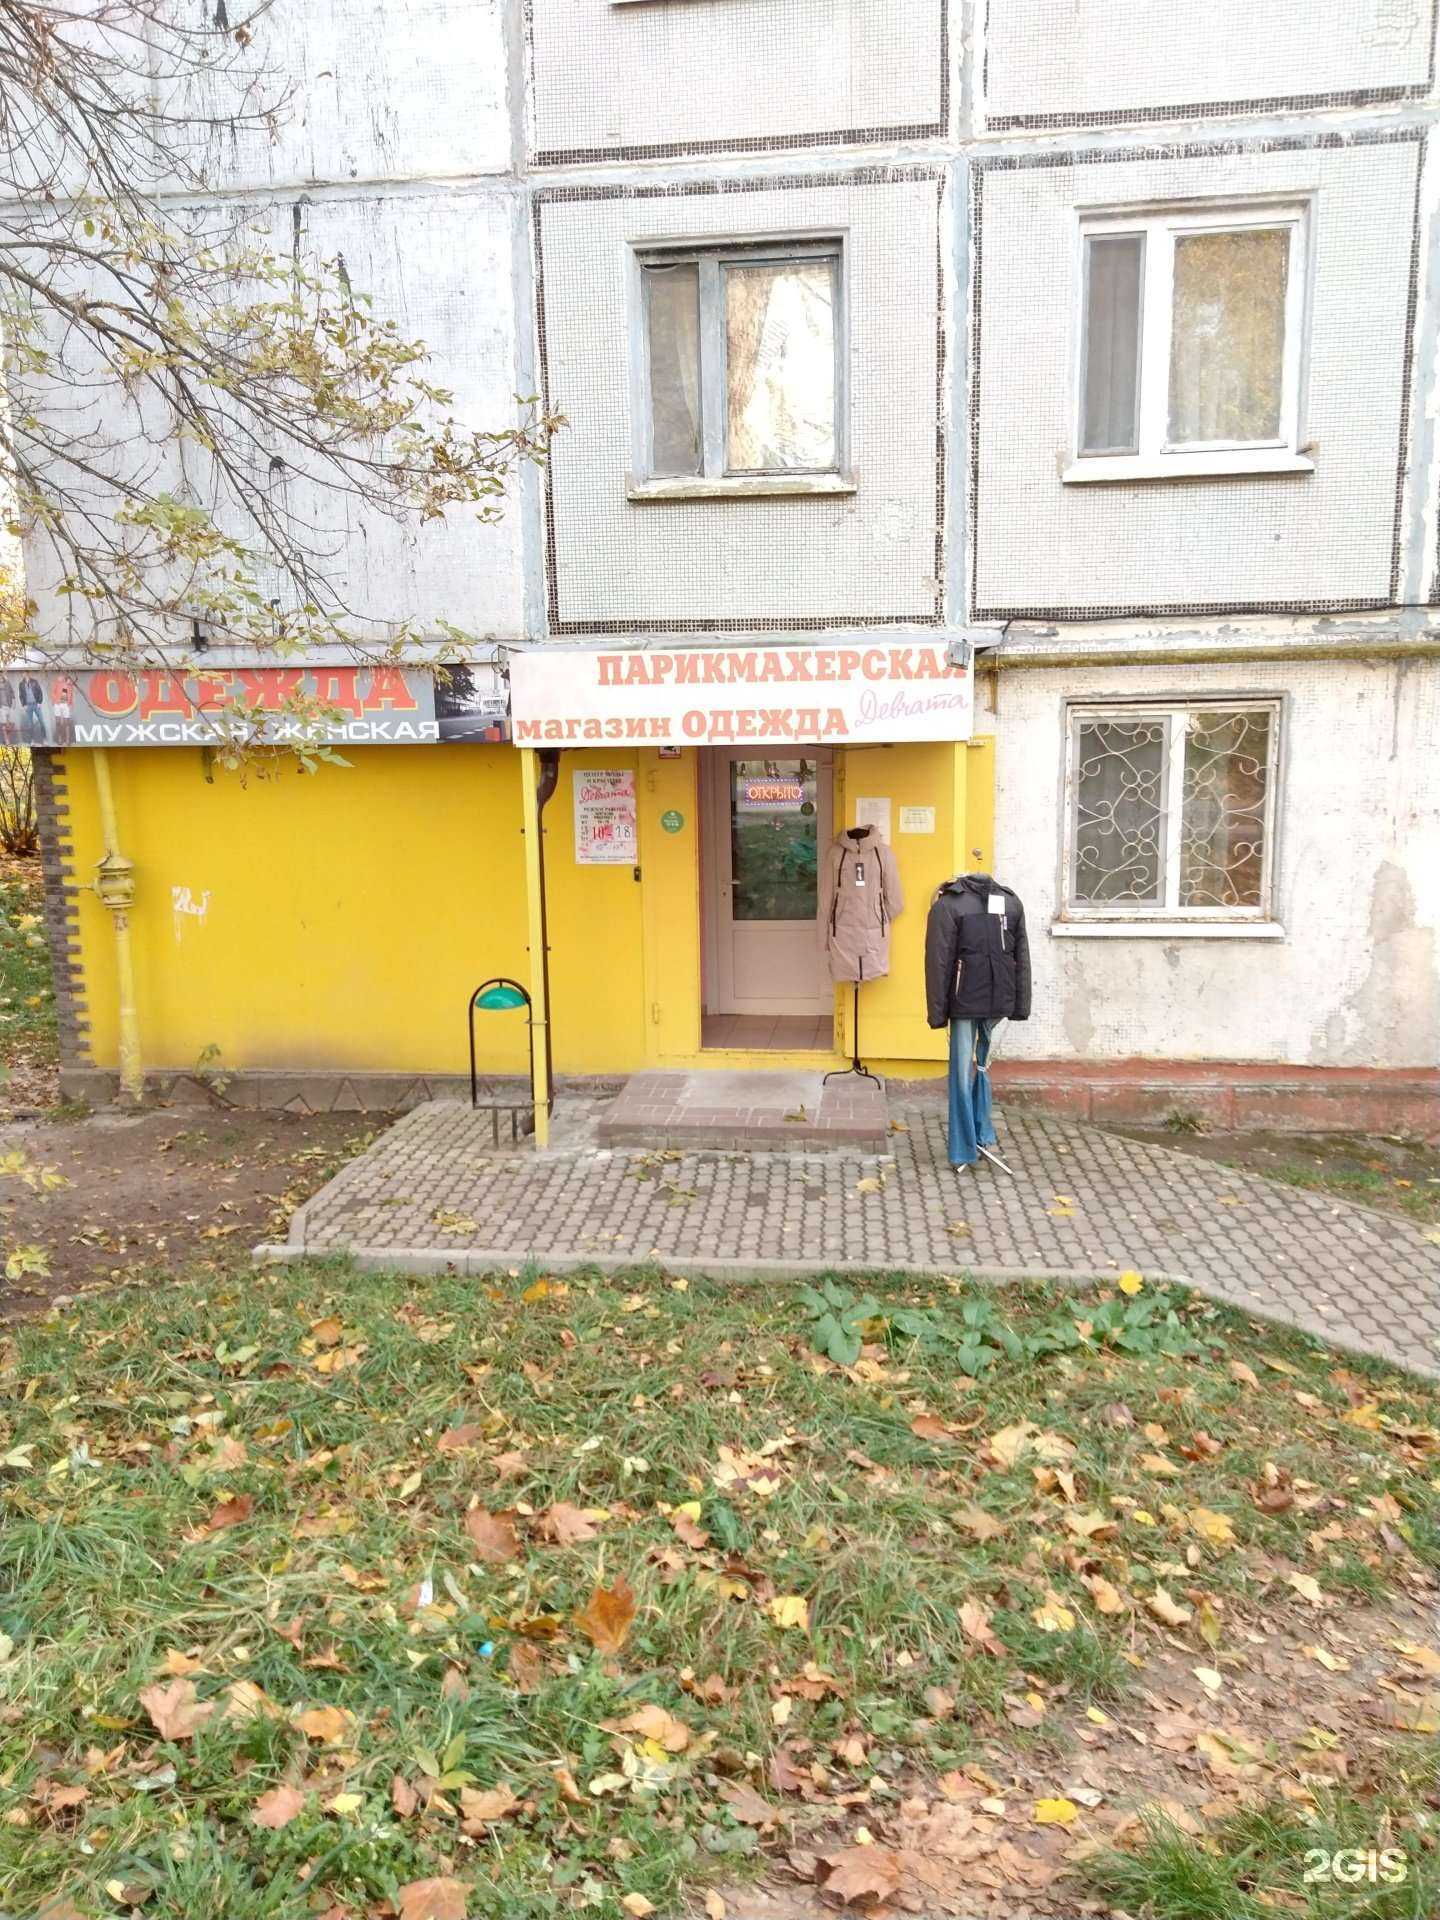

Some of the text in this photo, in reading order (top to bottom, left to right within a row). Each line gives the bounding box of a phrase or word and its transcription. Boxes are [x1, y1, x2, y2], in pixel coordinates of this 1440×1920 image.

[89, 666, 418, 720] ОДЕЖДА
[855, 688, 969, 729] Девчата
[74, 723, 249, 743] МУЖСКАЯ
[517, 707, 849, 743] магазин ОДЕЖДА
[748, 785, 802, 800] ОТКРЫТО
